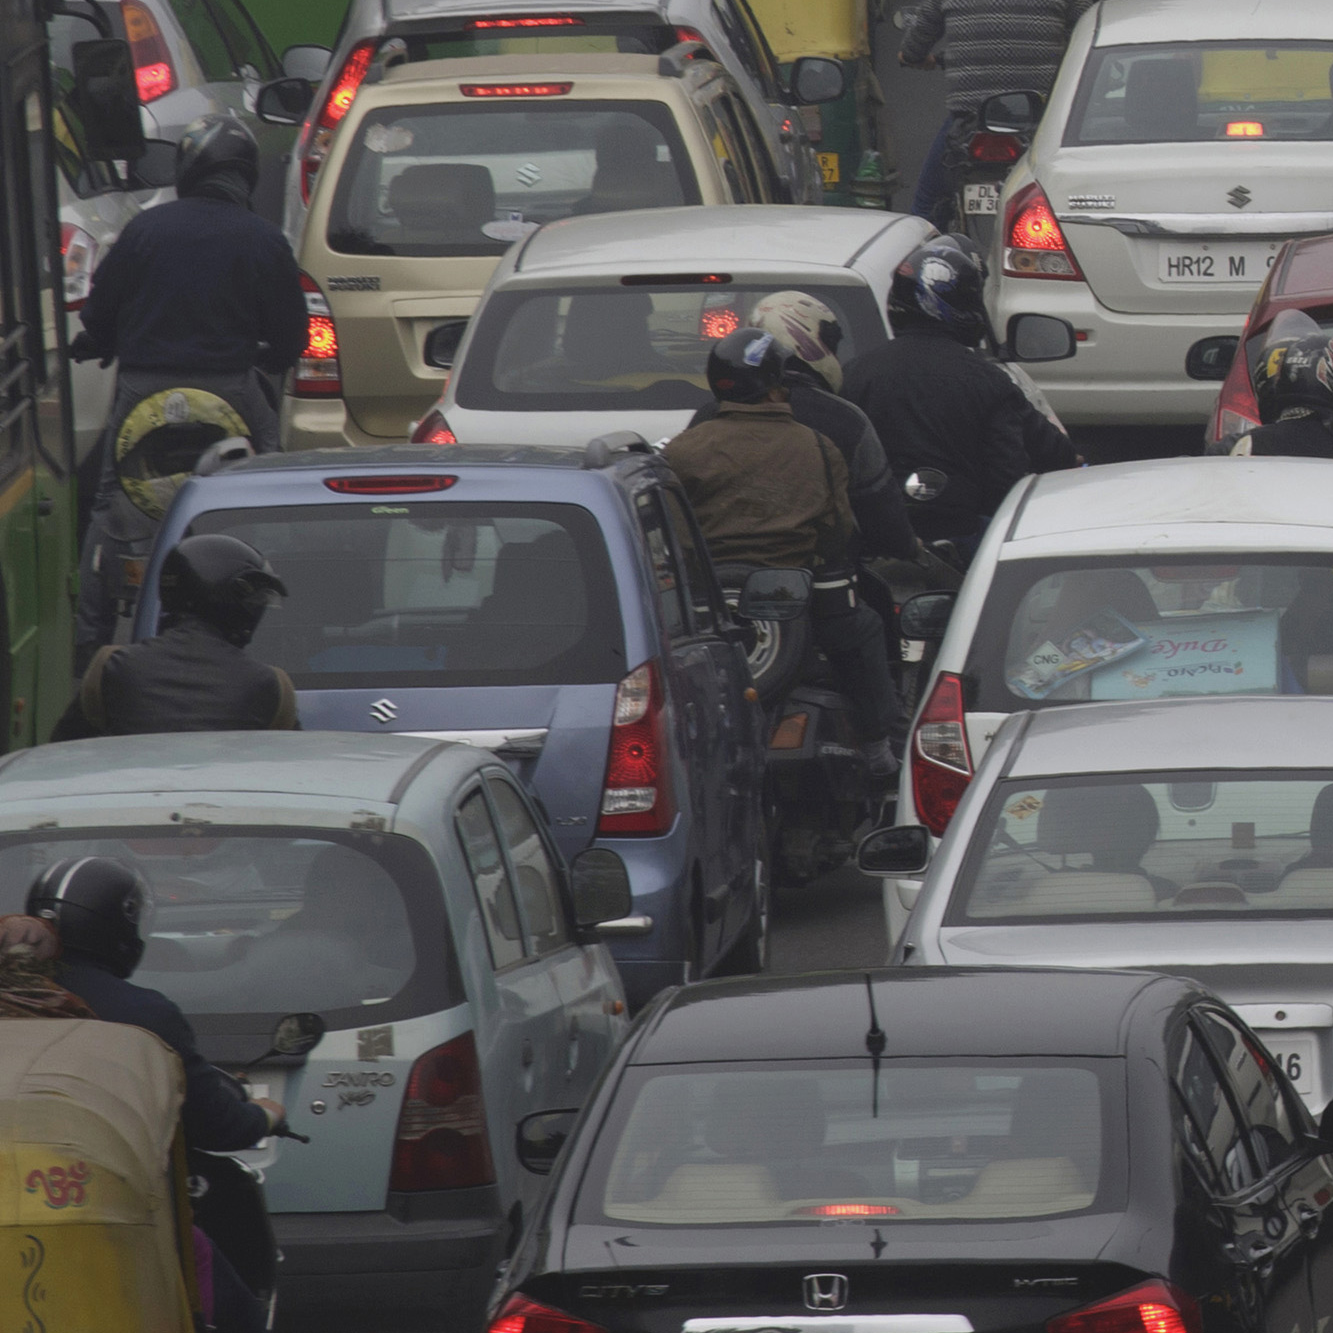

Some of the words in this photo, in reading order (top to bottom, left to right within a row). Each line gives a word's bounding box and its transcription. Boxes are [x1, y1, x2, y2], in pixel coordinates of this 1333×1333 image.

[1167, 258, 1214, 277] HR12
[1229, 258, 1245, 275] M
[1149, 638, 1229, 660] Duke
[1033, 653, 1060, 666] CNG
[321, 1071, 396, 1088] SANTRO
